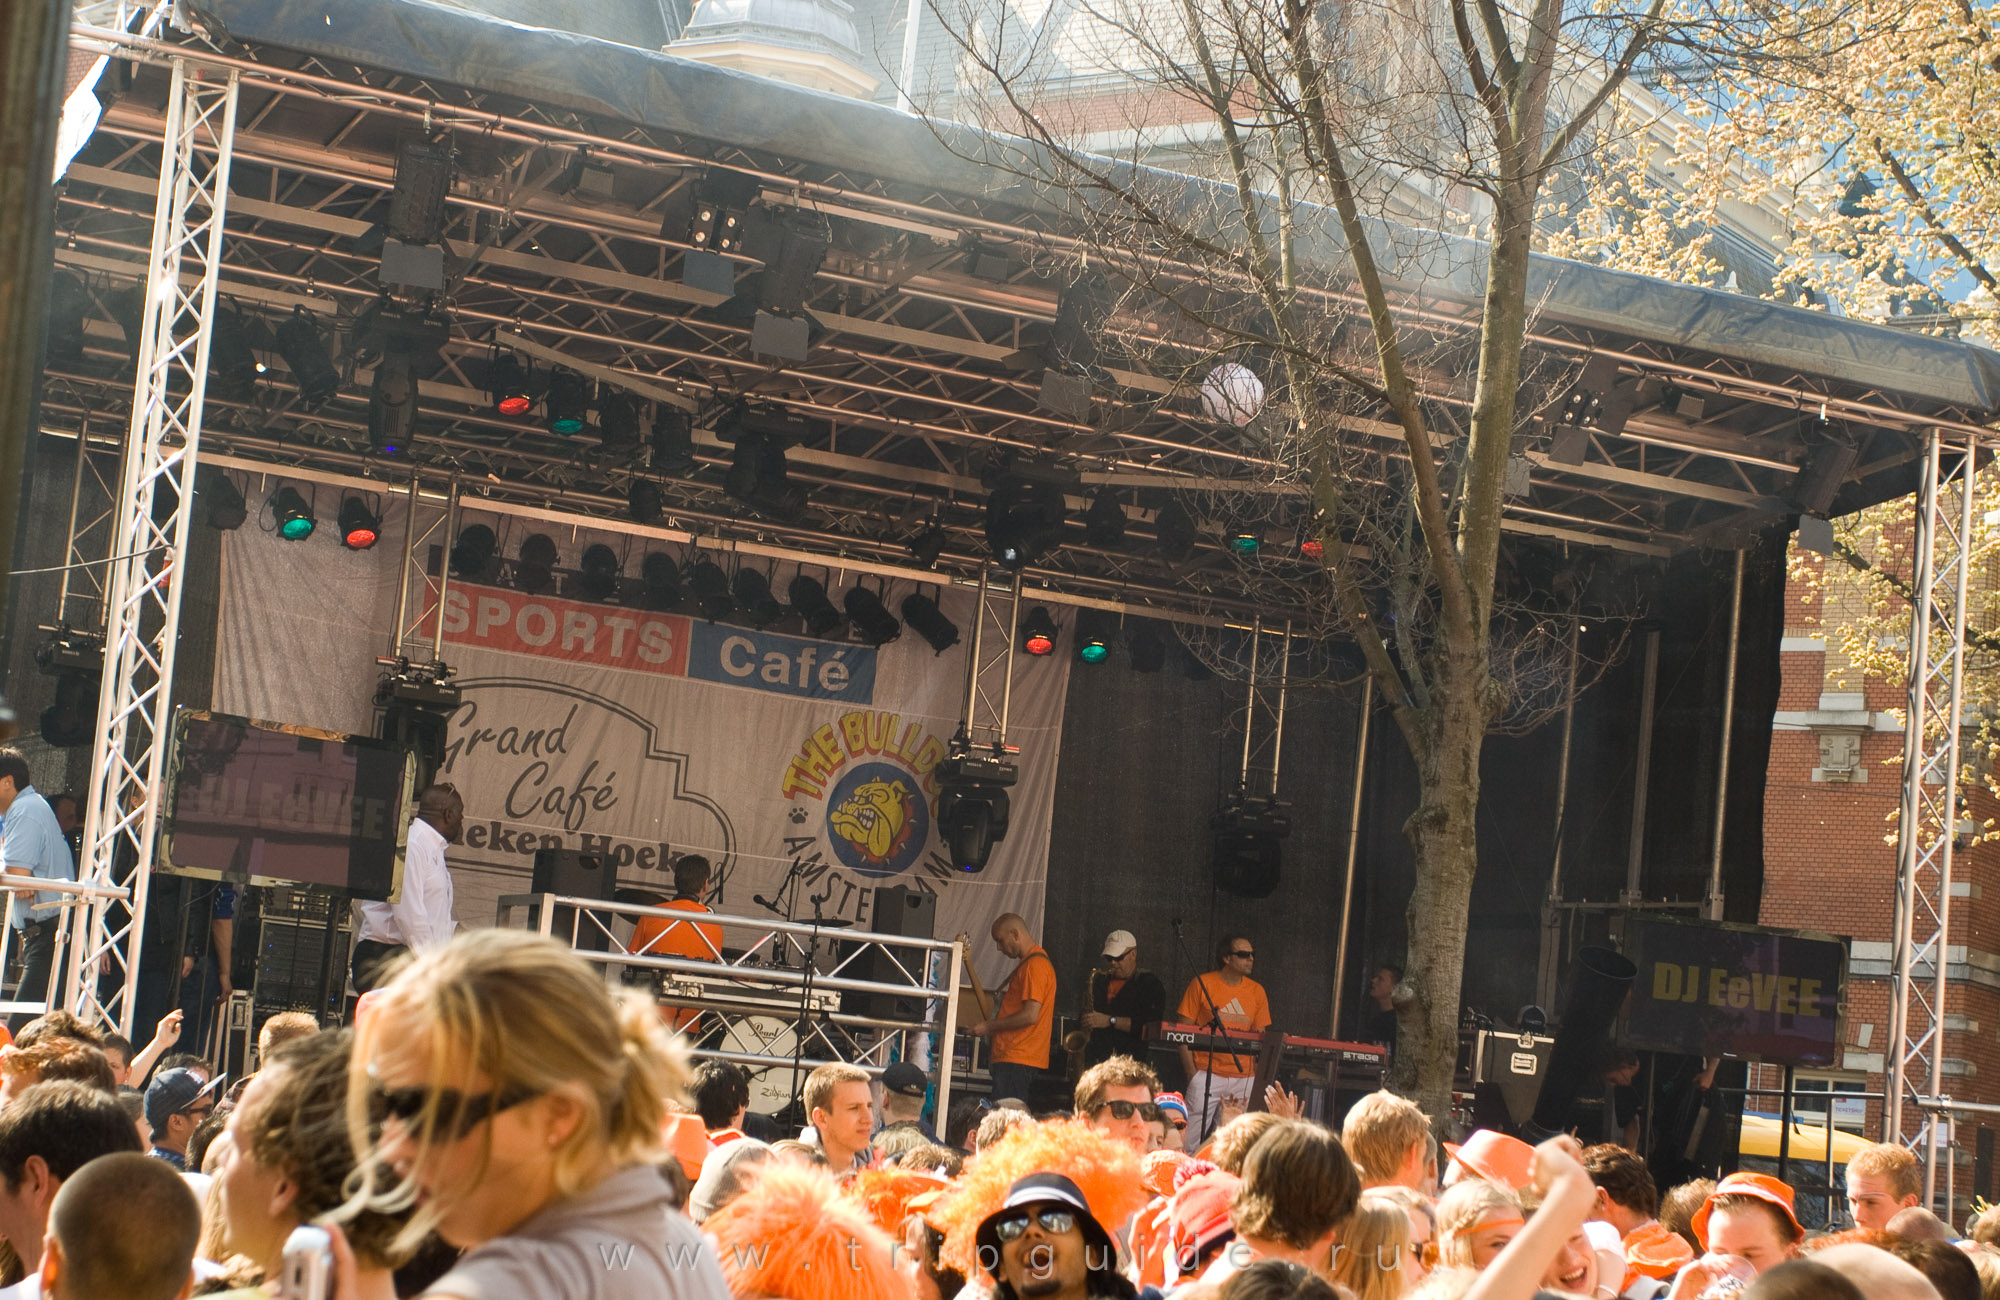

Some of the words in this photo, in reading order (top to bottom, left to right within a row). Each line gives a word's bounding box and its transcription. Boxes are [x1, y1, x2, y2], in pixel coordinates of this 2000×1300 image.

[443, 590, 673, 664] SPORTS
[720, 636, 849, 692] Café
[446, 701, 578, 774] Grand
[782, 723, 846, 800] THE
[838, 711, 946, 818] BULLD
[506, 760, 618, 835] Café
[450, 821, 564, 855] eken
[784, 837, 957, 922] AMSTEAM
[1653, 962, 1700, 1003] DJ
[1708, 968, 1822, 1017] EeVEE
[1166, 1032, 1195, 1044] nord
